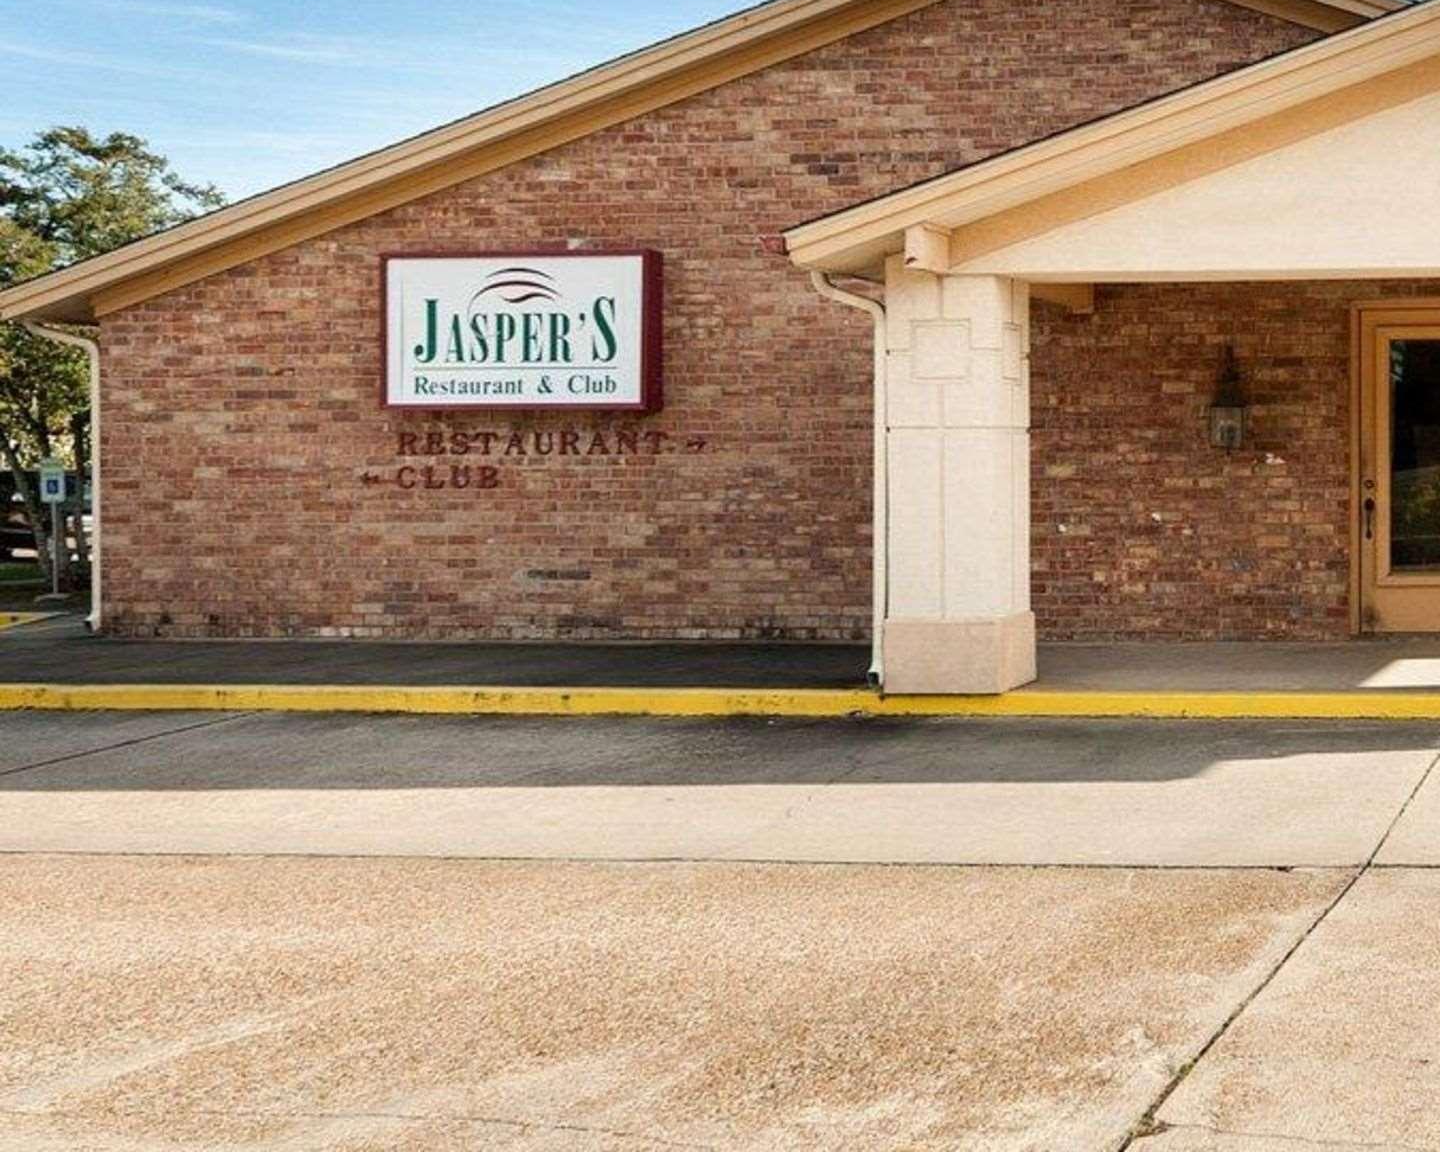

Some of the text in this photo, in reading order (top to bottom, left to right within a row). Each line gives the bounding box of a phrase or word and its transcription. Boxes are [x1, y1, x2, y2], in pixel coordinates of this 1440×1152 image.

[413, 296, 617, 363] JASPER'S
[413, 374, 617, 395] Restaurant & Club
[397, 431, 669, 456] RESTAURANT
[396, 465, 499, 490] CLUB
